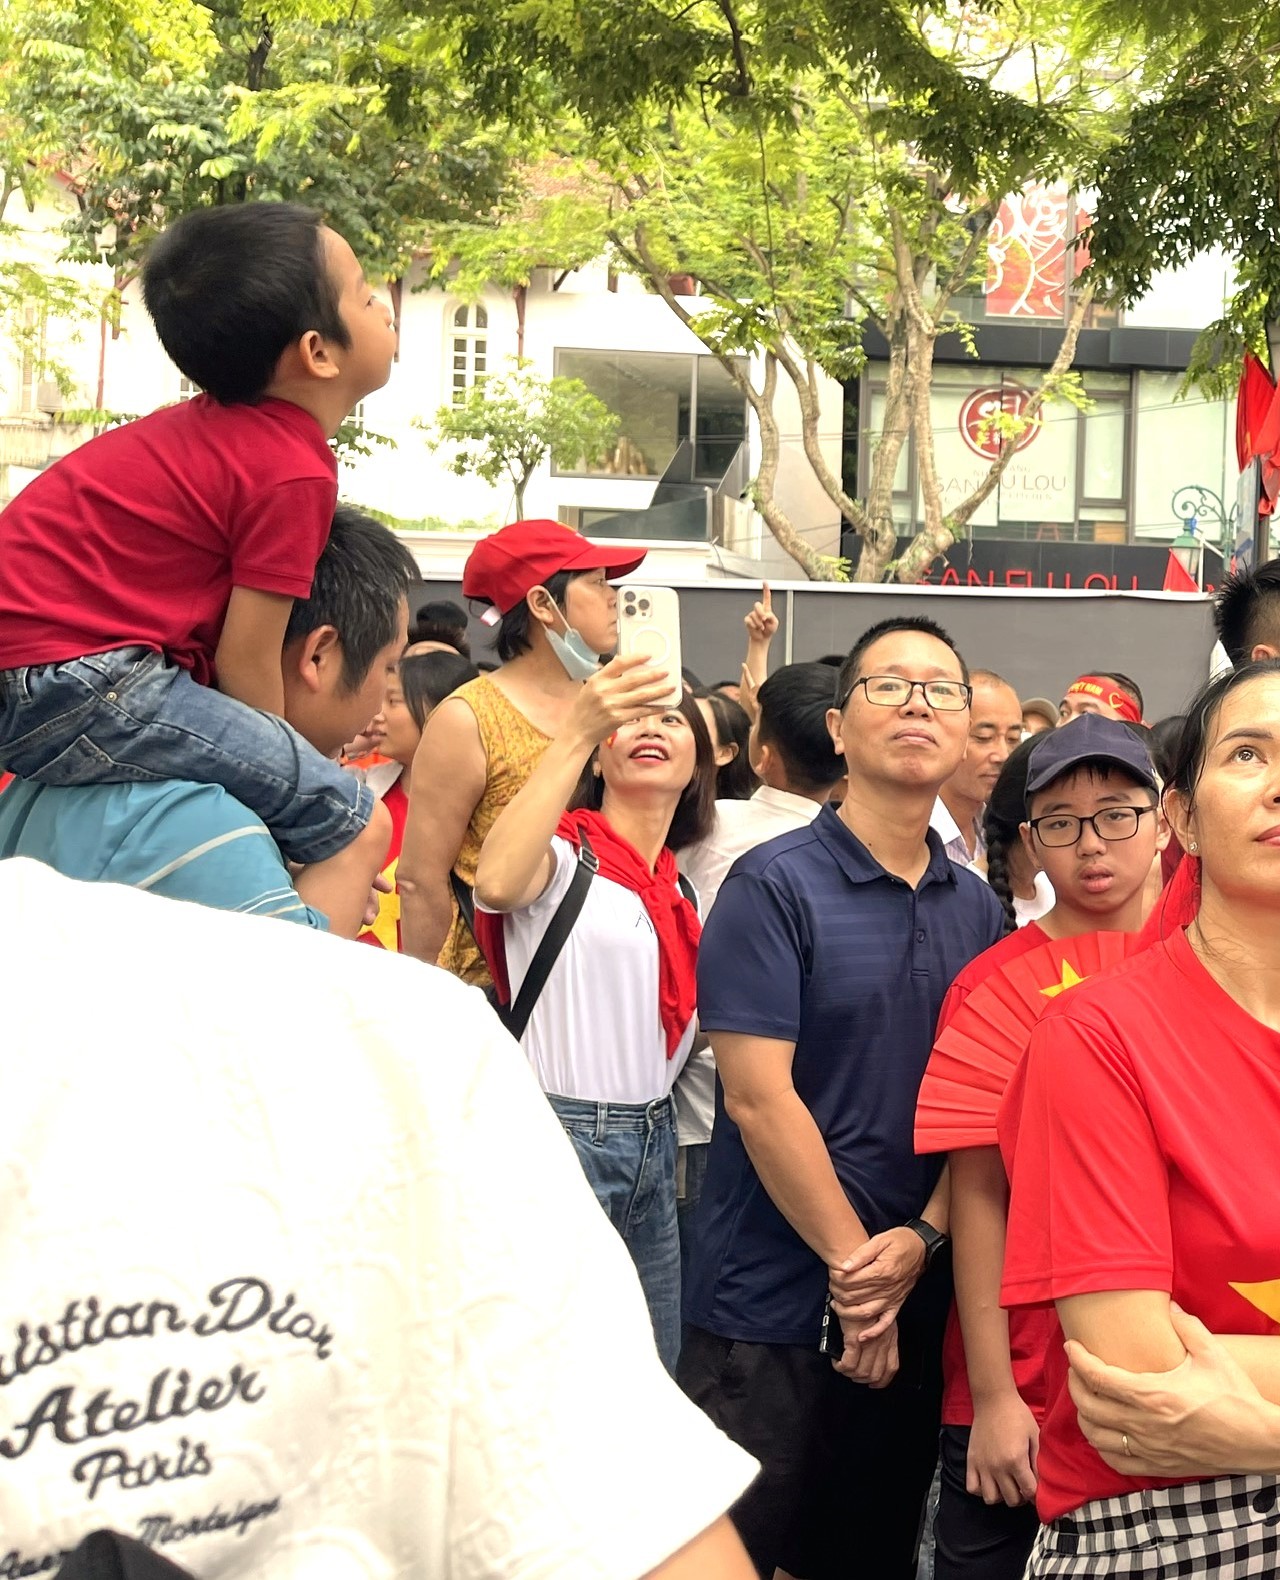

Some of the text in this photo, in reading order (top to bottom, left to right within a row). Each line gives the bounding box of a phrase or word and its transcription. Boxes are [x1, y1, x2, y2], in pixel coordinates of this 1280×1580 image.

[1023, 474, 1067, 491] LOU
[191, 1276, 334, 1360] Dior
[0, 1363, 266, 1459] Atelier
[72, 1437, 212, 1500] Paris
